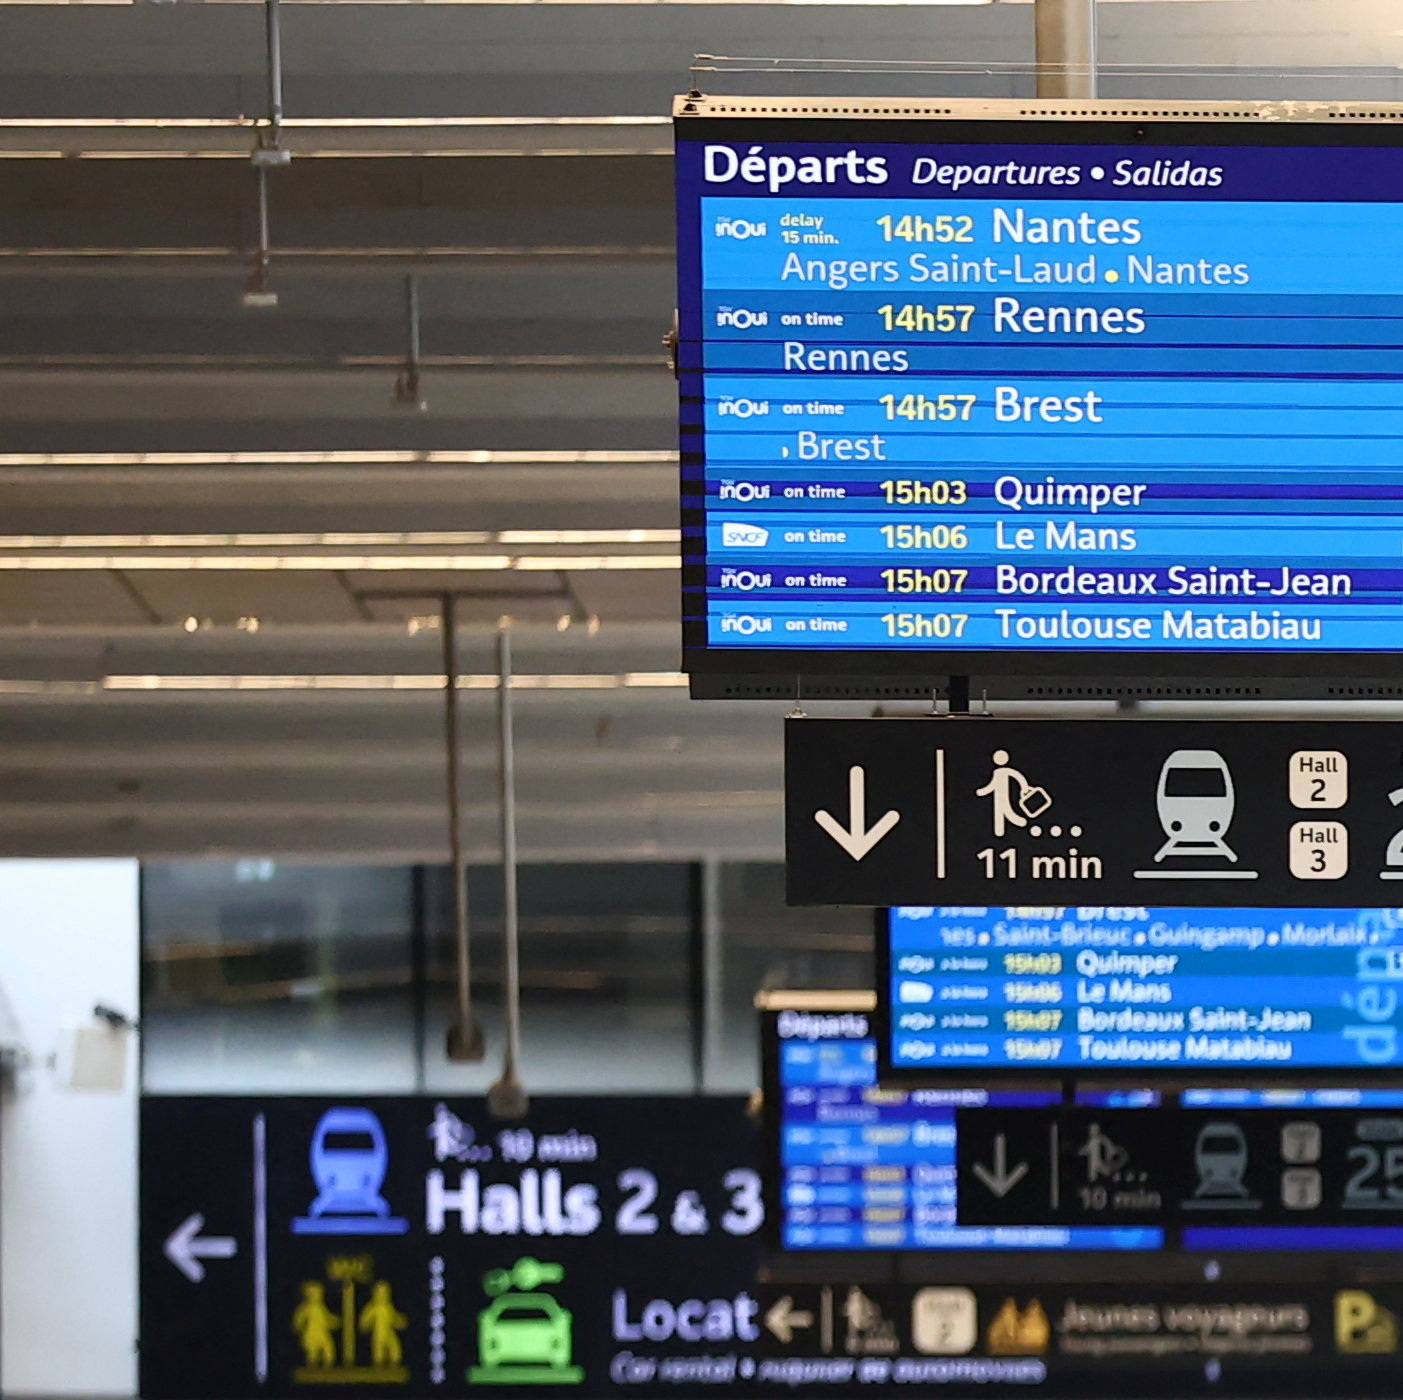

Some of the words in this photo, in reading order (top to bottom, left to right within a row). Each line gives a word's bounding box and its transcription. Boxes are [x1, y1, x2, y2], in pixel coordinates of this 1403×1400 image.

[705, 146, 887, 192] Départs
[913, 159, 1080, 190] Departures
[1113, 160, 1222, 185] Salidas
[781, 214, 822, 232] delay
[782, 231, 799, 243] 15
[804, 232, 838, 243] min.
[877, 216, 973, 242] 14h52
[994, 209, 1140, 244] Nantes
[783, 253, 898, 289] Angers
[910, 254, 1094, 282] Saint-Laud
[1129, 256, 1248, 284] Nantes
[782, 315, 801, 324] on
[806, 313, 842, 325] time
[879, 305, 974, 331] 14h57
[995, 298, 1144, 333] Rennes
[785, 342, 907, 371] Rennes
[880, 395, 976, 420] 14h57
[996, 387, 1102, 422] Brest
[799, 432, 885, 459] Brest
[880, 481, 966, 504] 15h03
[995, 477, 1146, 513] Quimper
[881, 526, 967, 548] 15h06
[997, 521, 1034, 549] Le
[1047, 521, 1136, 550] Mans
[881, 570, 967, 592] 15h07
[998, 565, 1156, 594] Bordeaux
[1169, 566, 1350, 595] Saint-Jean
[882, 614, 968, 637] 15h07
[996, 610, 1151, 638] Toulouse
[1164, 611, 1320, 639] Matabiau
[1300, 757, 1337, 772] Hall
[1311, 779, 1325, 801] 2
[1301, 828, 1337, 843] Hall
[978, 849, 1015, 878] 11
[1033, 849, 1101, 878] min
[1311, 849, 1326, 872] 3
[1077, 951, 1177, 977] Quimper
[1078, 981, 1105, 1002] Le
[1110, 980, 1171, 1002] Mans
[1078, 1007, 1184, 1031] Bordeaux
[1190, 1007, 1311, 1031] Saint-Jean
[1080, 1036, 1181, 1059] Toulouse
[1186, 1036, 1291, 1059] Matabiau
[427, 1169, 600, 1235] Halls
[617, 1171, 657, 1233] 2
[672, 1192, 706, 1234] &
[723, 1171, 764, 1234] 3
